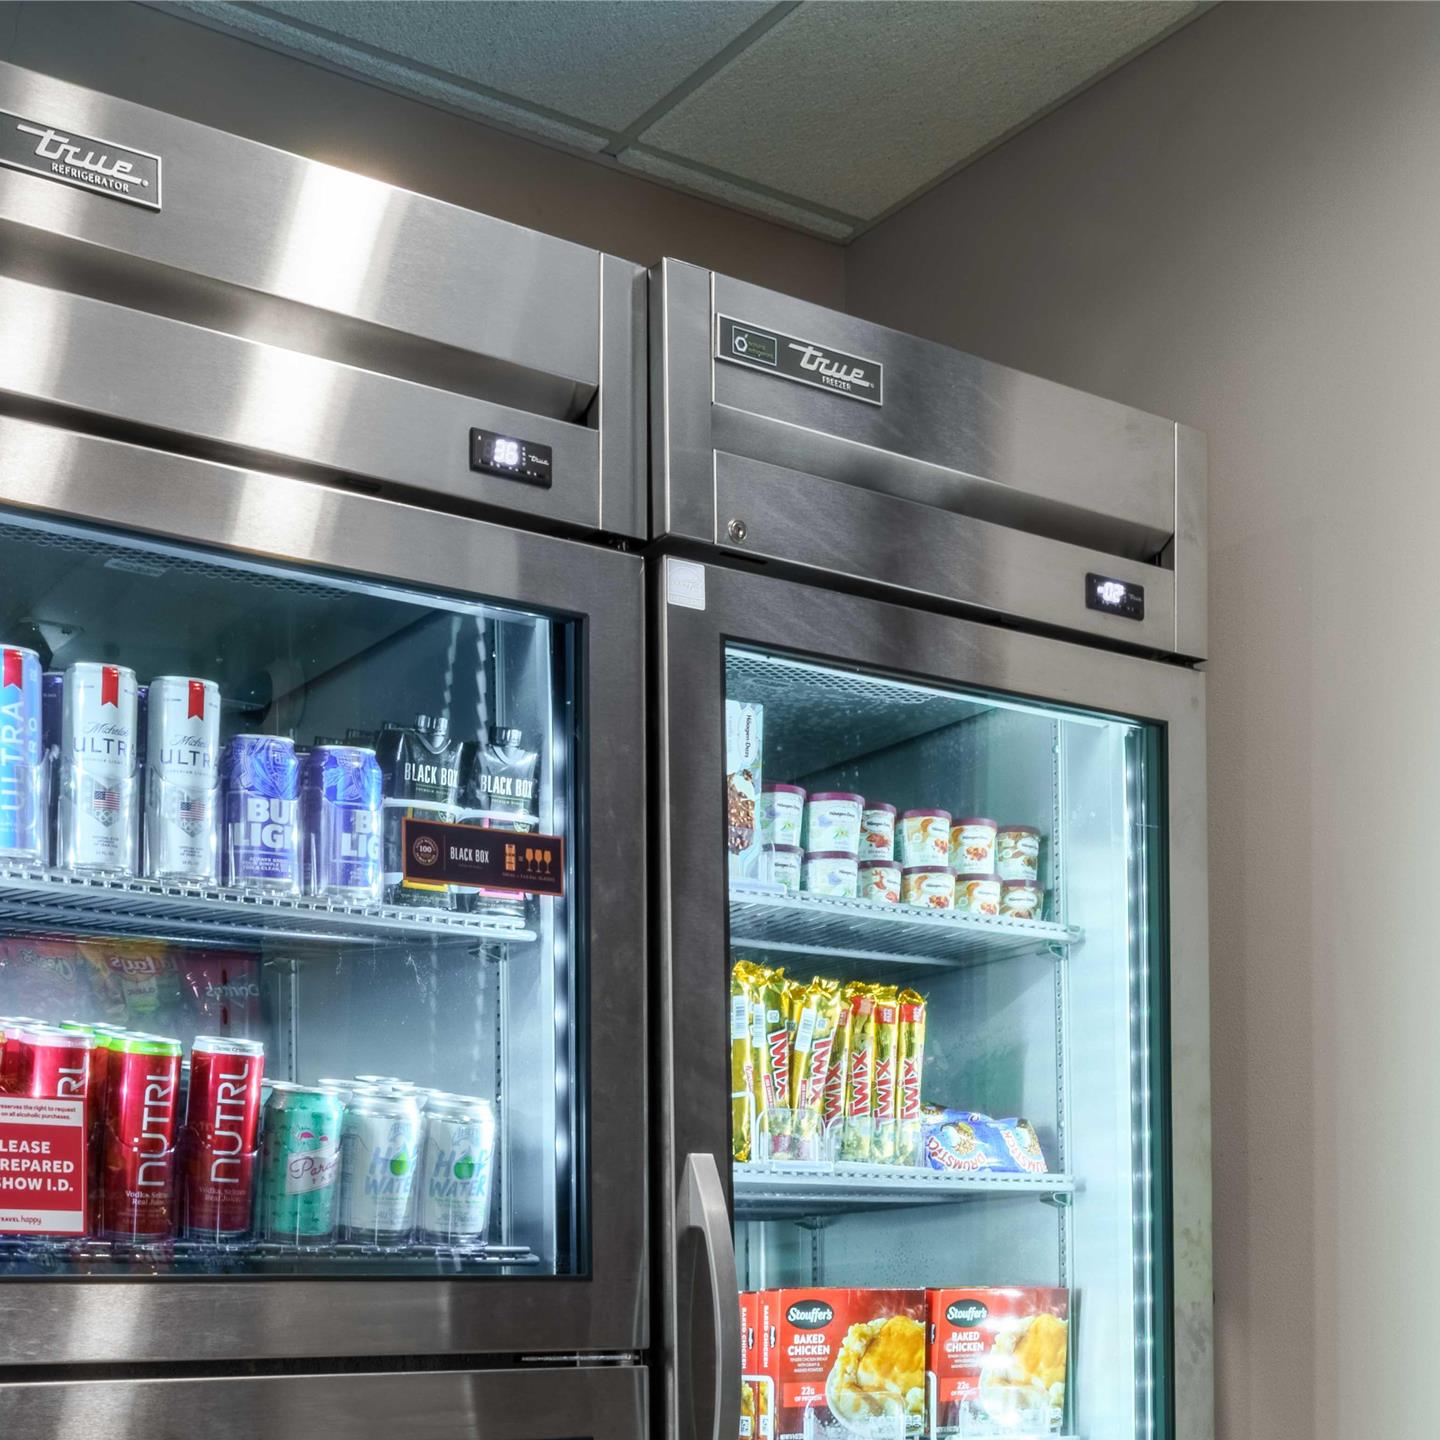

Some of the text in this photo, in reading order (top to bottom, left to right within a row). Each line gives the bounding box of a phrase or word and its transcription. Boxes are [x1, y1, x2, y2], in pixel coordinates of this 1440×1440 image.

[51, 162, 130, 193] REFRIGERATOR
[822, 376, 852, 392] FREEZER
[1, 700, 25, 811] ULTRA
[160, 748, 217, 769] ULTR
[404, 762, 458, 787] BLACK BOX
[481, 775, 533, 798] BLACK BOX
[247, 798, 294, 825] BU
[234, 823, 293, 850] LIG
[342, 832, 379, 860] LIG
[450, 846, 473, 862] BLACK
[475, 849, 489, 863] BOX
[849, 1050, 870, 1117] TWIX
[900, 1059, 920, 1120] TWIX
[33, 1104, 47, 1112] right
[47, 1178, 74, 1192] I.D.
[429, 1176, 486, 1198] WATER
[20, 1215, 42, 1225] happy
[787, 1307, 833, 1323] Stouffer's
[946, 1306, 988, 1321] Stouffer's
[793, 1334, 825, 1344] BAKED
[951, 1332, 980, 1341] BAKED
[787, 1345, 830, 1356] CHICKEN
[946, 1342, 984, 1352] CHICKEN
